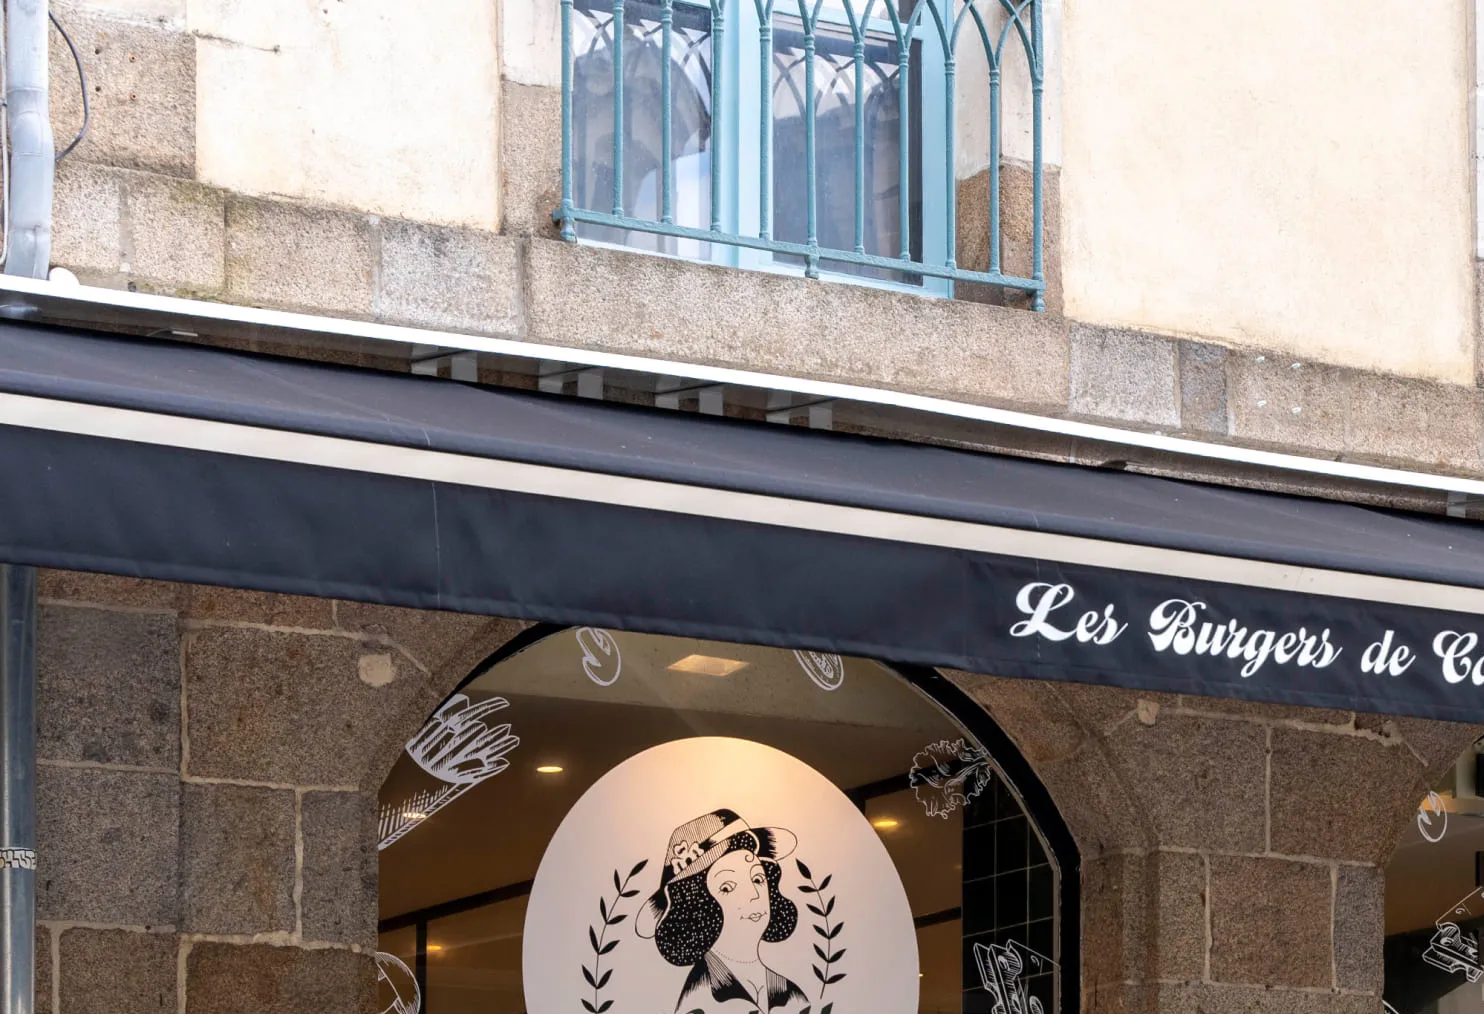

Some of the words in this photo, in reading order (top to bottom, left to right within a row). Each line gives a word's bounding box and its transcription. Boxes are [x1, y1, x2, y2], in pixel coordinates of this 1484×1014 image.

[1009, 582, 1128, 644] Les
[1148, 598, 1344, 678] Burgers
[1360, 629, 1417, 677] de
